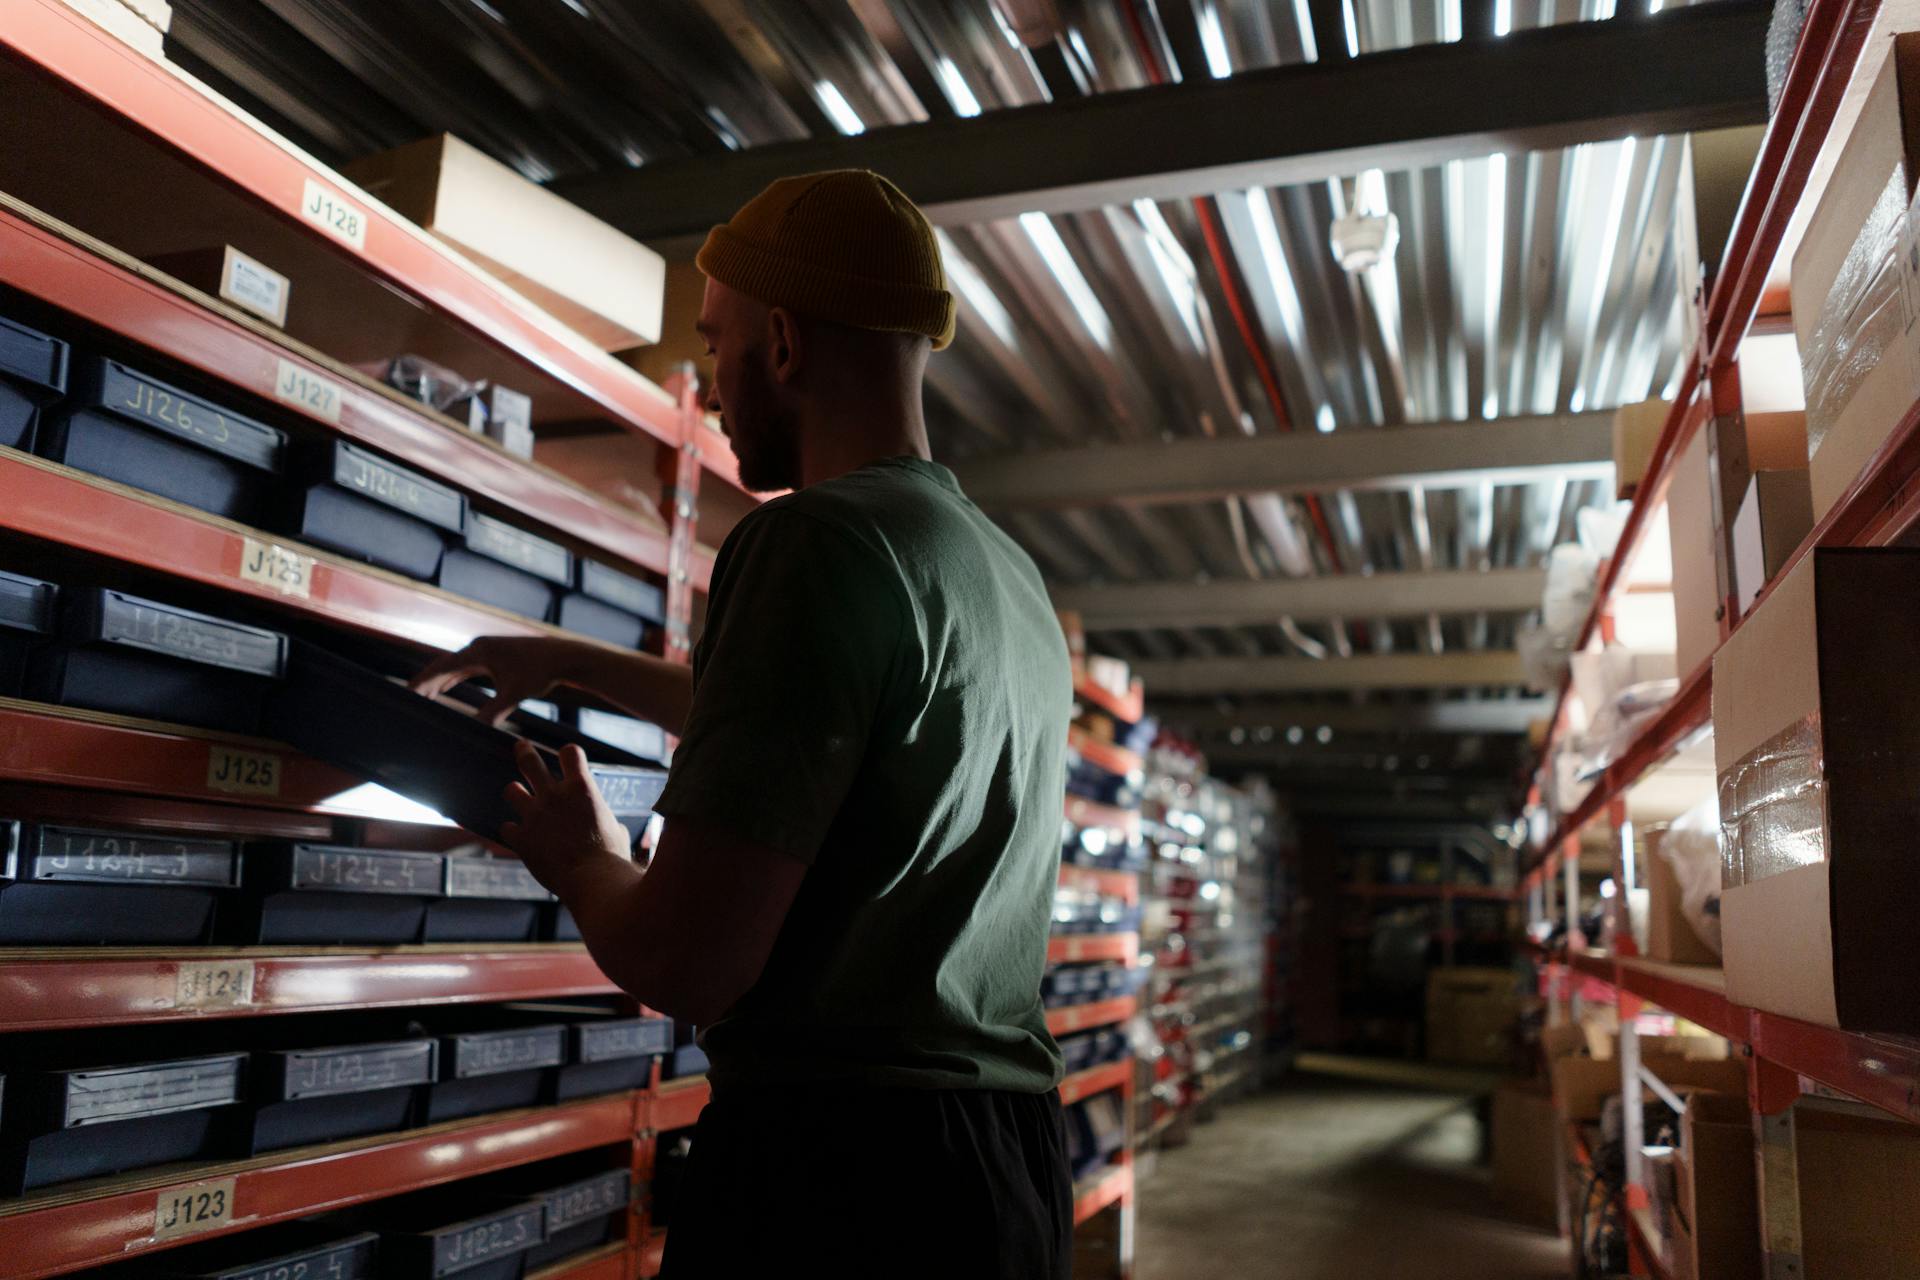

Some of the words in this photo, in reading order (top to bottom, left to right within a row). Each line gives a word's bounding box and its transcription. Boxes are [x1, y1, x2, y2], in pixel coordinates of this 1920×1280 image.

[310, 194, 358, 237] J128
[283, 371, 336, 411] J127
[215, 753, 273, 787] J125
[184, 969, 244, 998] J124
[163, 1190, 225, 1228] J123
